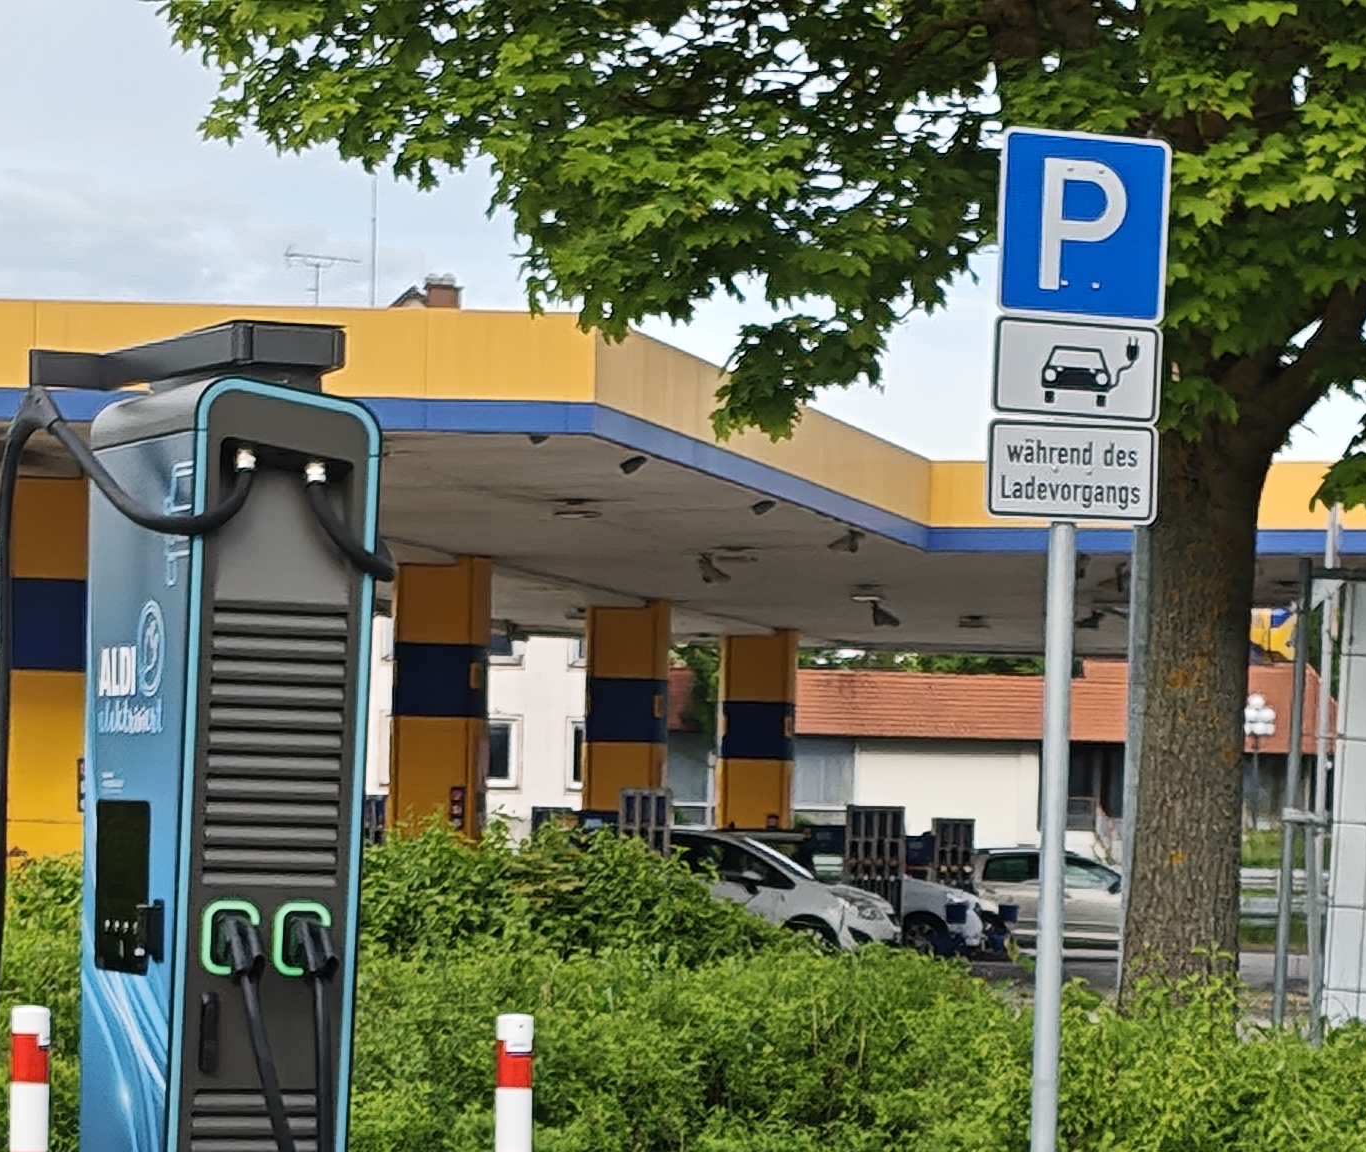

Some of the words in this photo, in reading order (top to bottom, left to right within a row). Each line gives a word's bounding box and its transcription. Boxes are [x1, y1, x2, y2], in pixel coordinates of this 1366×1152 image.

[1038, 156, 1128, 291] P
[1006, 438, 1093, 467] während
[1103, 443, 1138, 468] des
[1000, 474, 1141, 511] Ladevorgangs
[98, 645, 137, 697] ALDI
